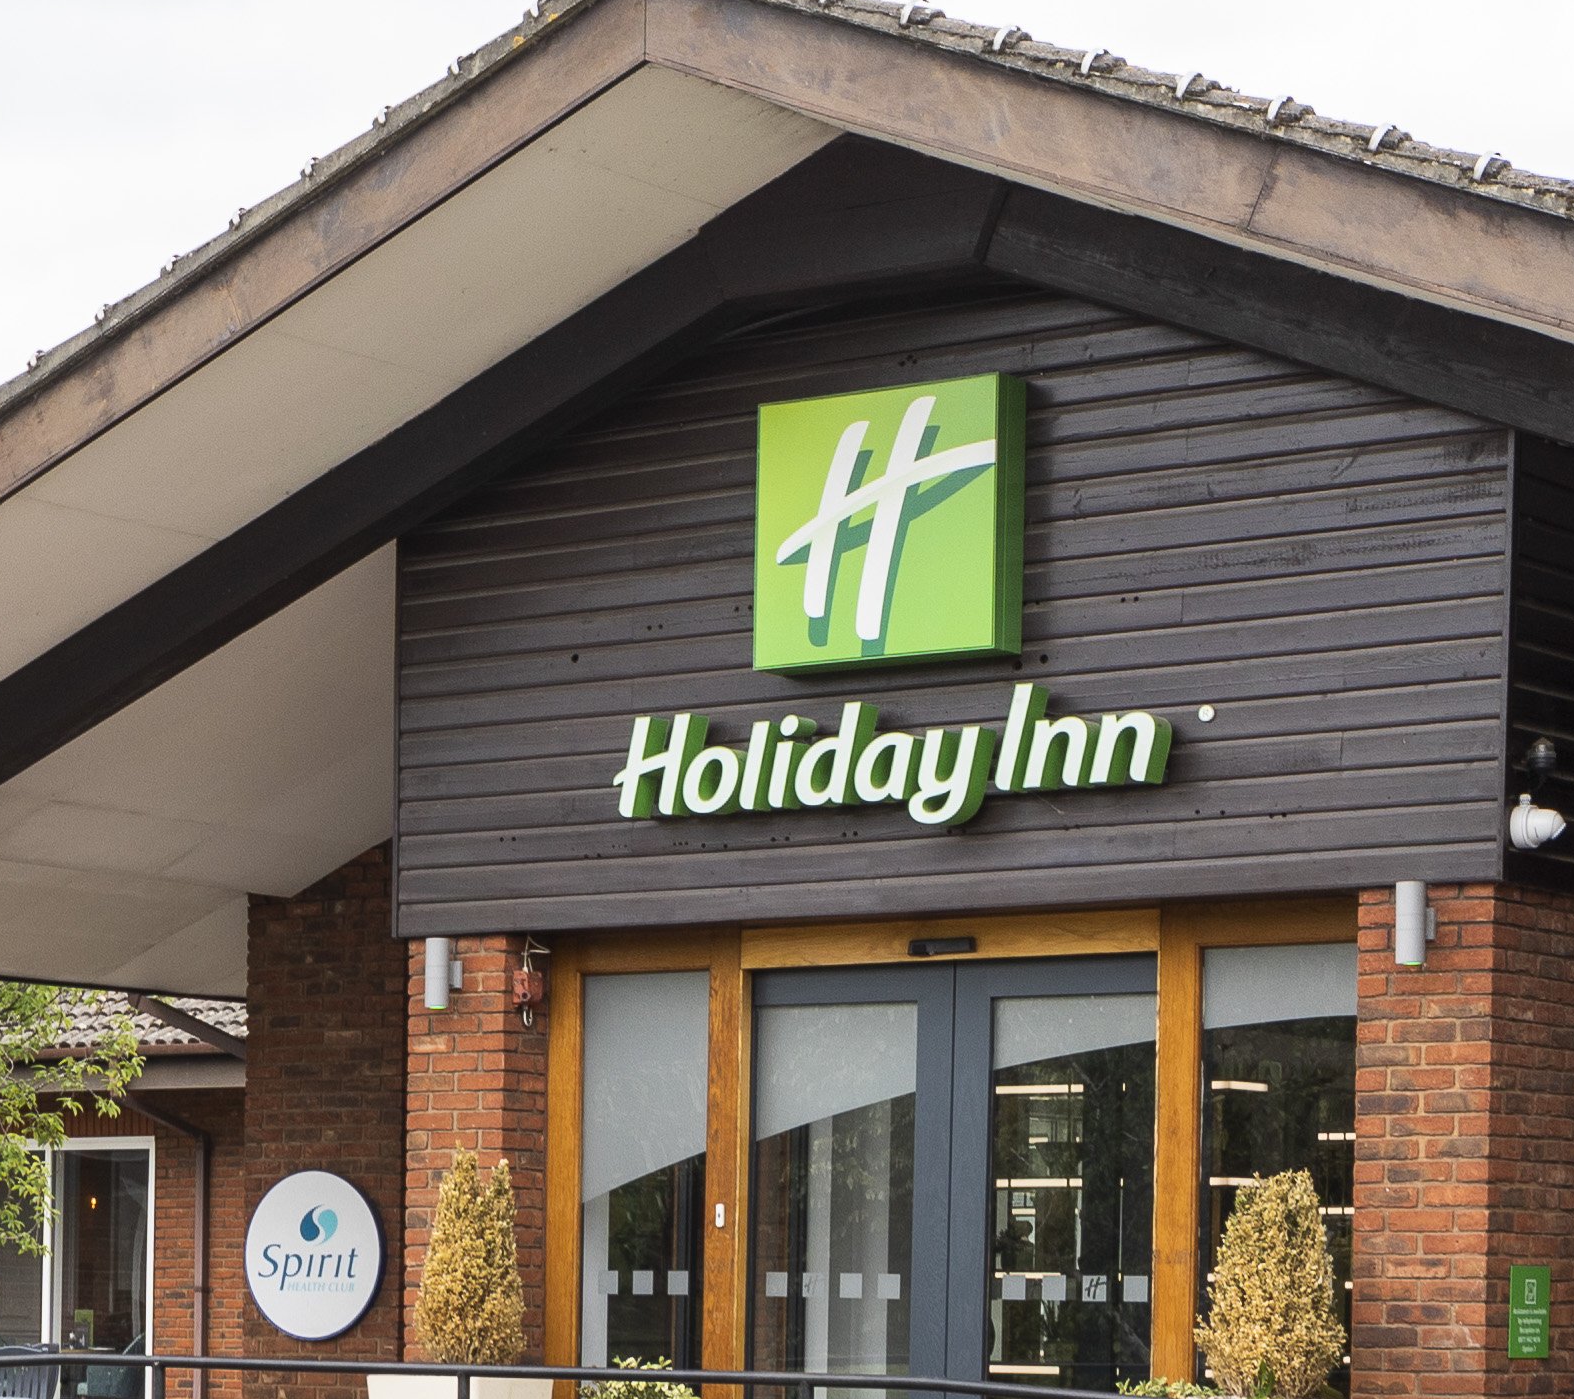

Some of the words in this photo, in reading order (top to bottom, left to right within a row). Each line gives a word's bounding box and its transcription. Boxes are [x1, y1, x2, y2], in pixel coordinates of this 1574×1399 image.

[613, 701, 990, 825] Holiday
[995, 683, 1167, 792] Inn
[258, 1243, 358, 1291] Spirit
[287, 1282, 326, 1292] HEALTH
[328, 1282, 355, 1292] CLUB
